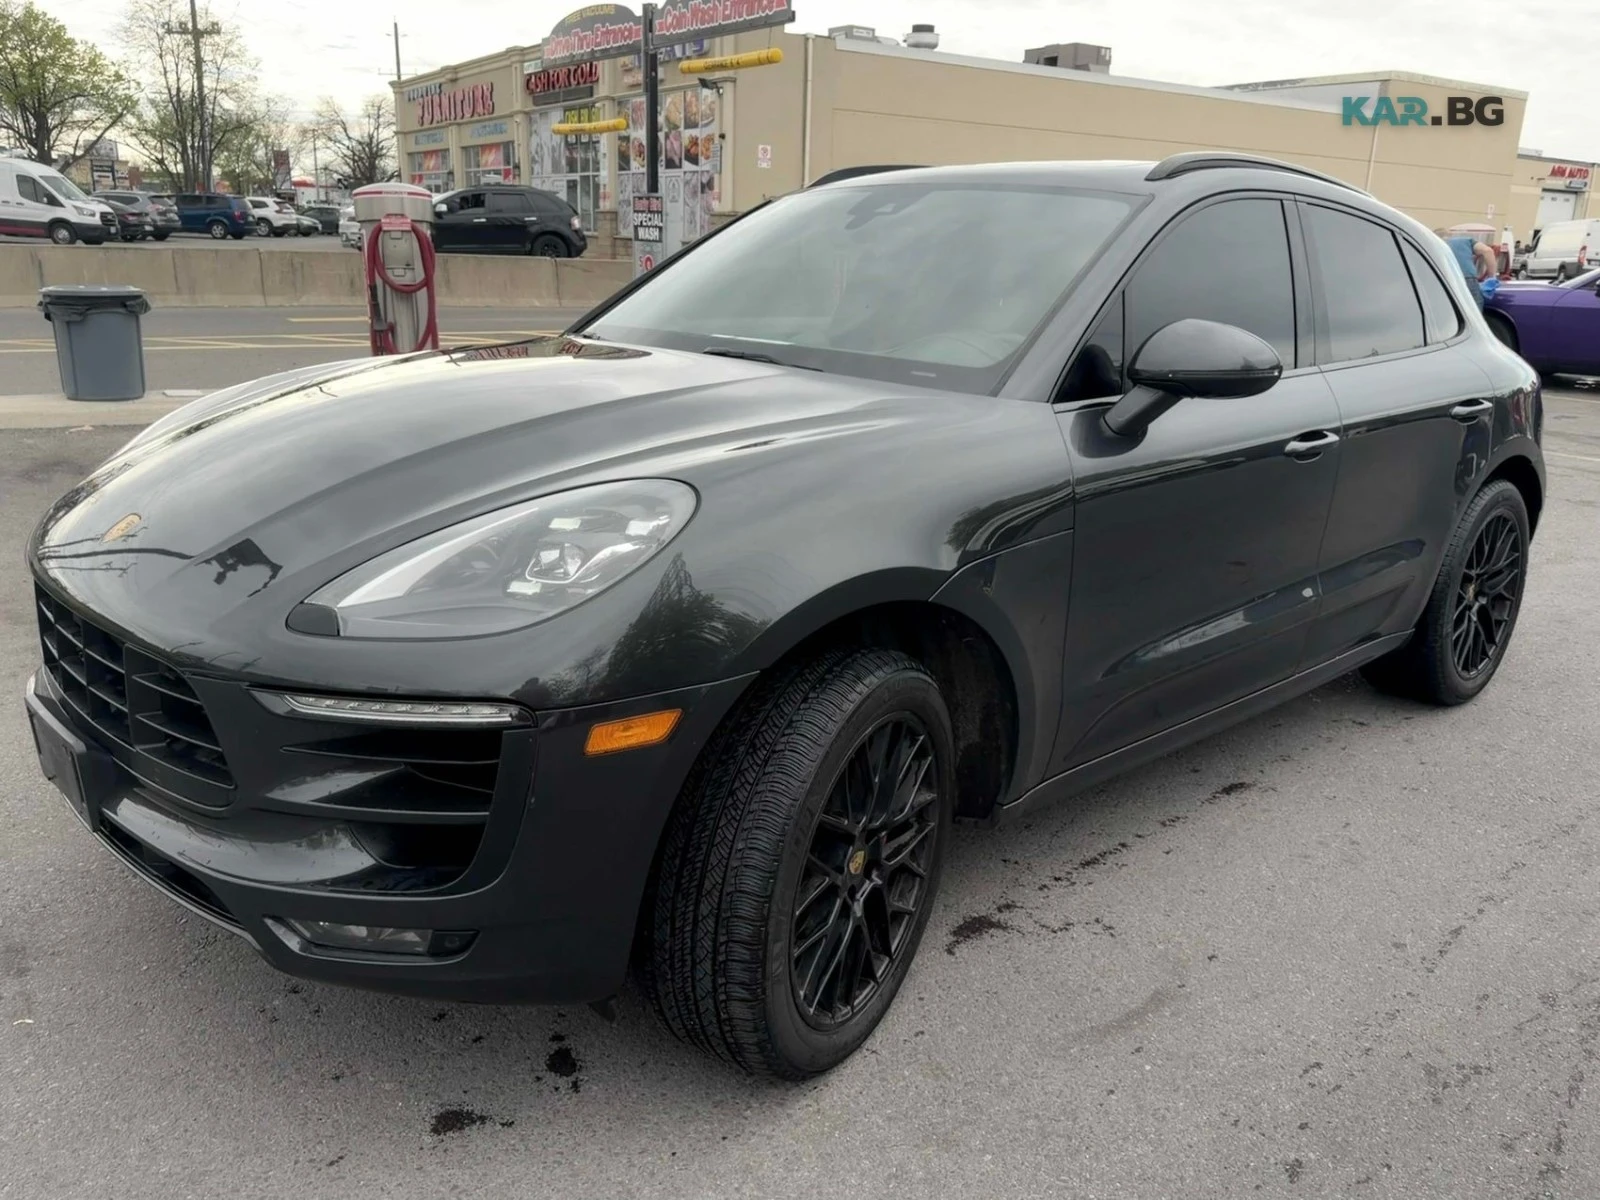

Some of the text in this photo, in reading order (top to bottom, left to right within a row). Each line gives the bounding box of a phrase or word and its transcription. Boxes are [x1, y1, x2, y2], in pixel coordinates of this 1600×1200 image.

[664, 6, 690, 34] Coin
[688, 0, 719, 29] Wash
[593, 22, 635, 50] Entrance
[525, 70, 550, 95] CASH
[550, 66, 571, 90] FOR
[571, 60, 600, 86] GOLD
[416, 81, 495, 127] FURNITURE
[632, 212, 663, 226] SPECIAL
[637, 226, 660, 241] WASH
